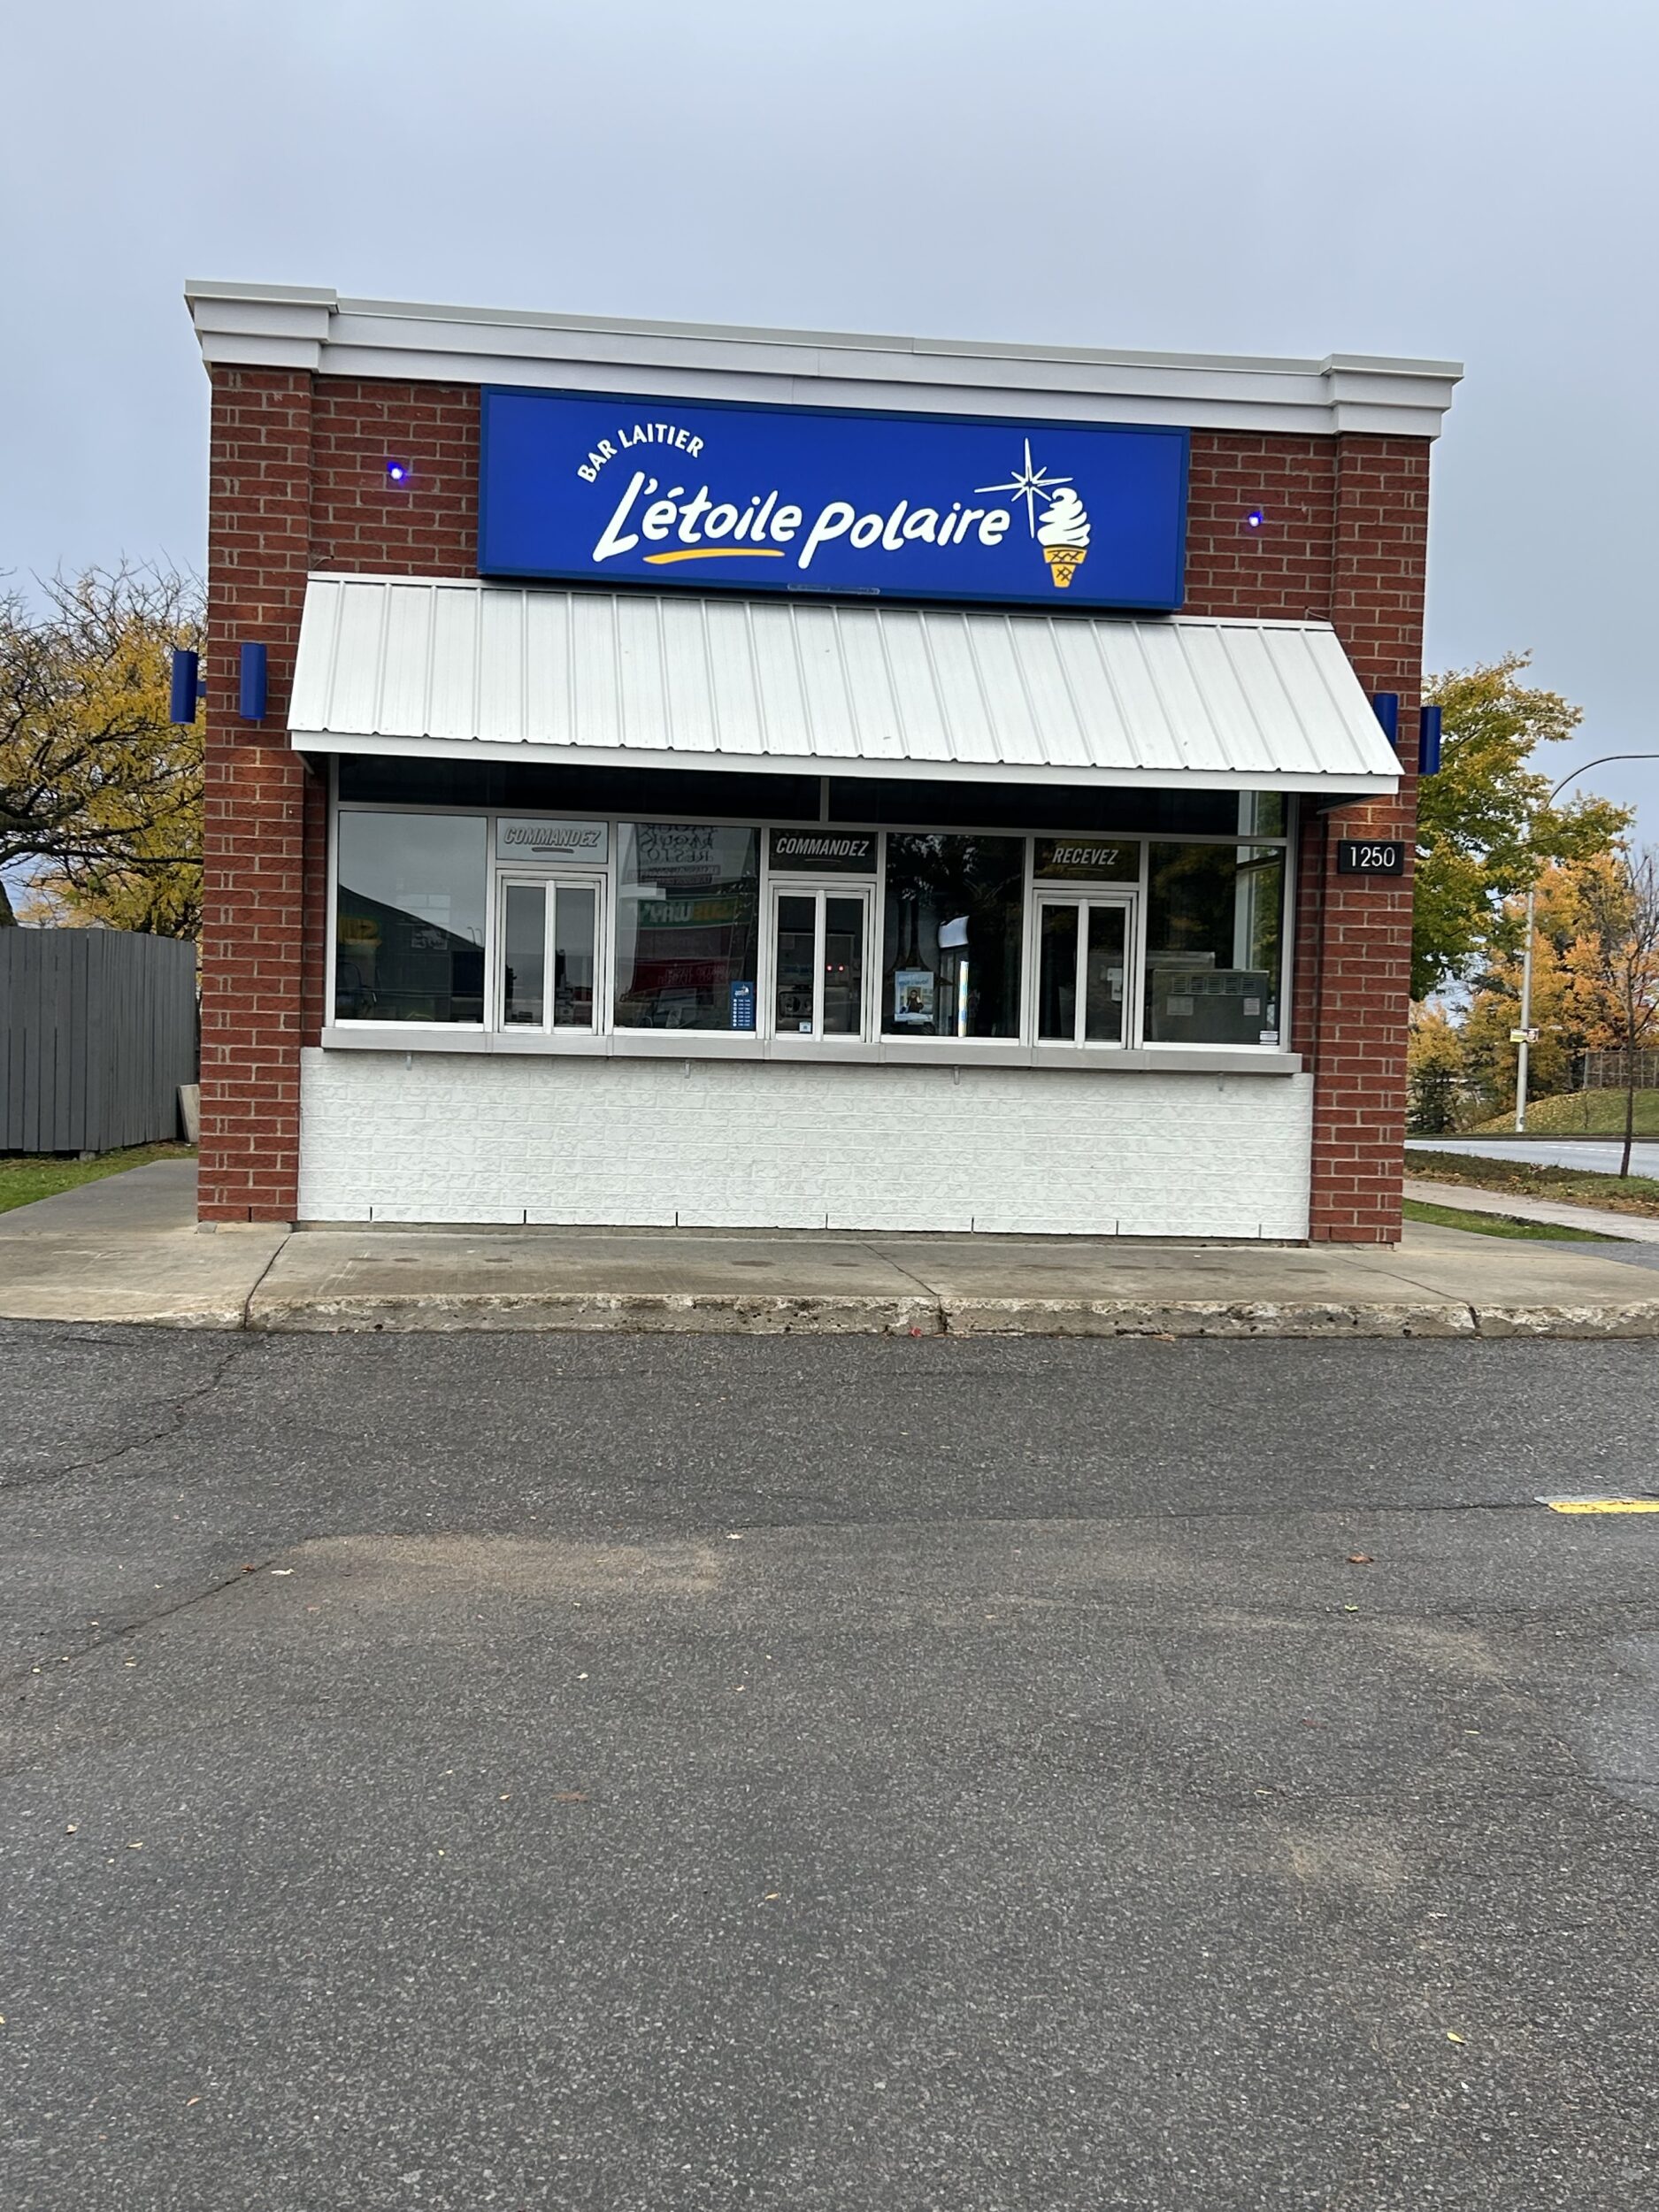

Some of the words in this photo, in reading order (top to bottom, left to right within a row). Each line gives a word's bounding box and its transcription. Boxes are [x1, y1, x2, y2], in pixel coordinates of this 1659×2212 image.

[577, 439, 618, 483] BAR
[618, 423, 704, 458] LAITIER
[592, 471, 803, 563] L'étoile
[504, 826, 602, 848] COMMANDEZ
[776, 837, 870, 856] COMMANDEZ
[1051, 848, 1119, 865] RECEVEZ
[1350, 846, 1395, 867] 1250
